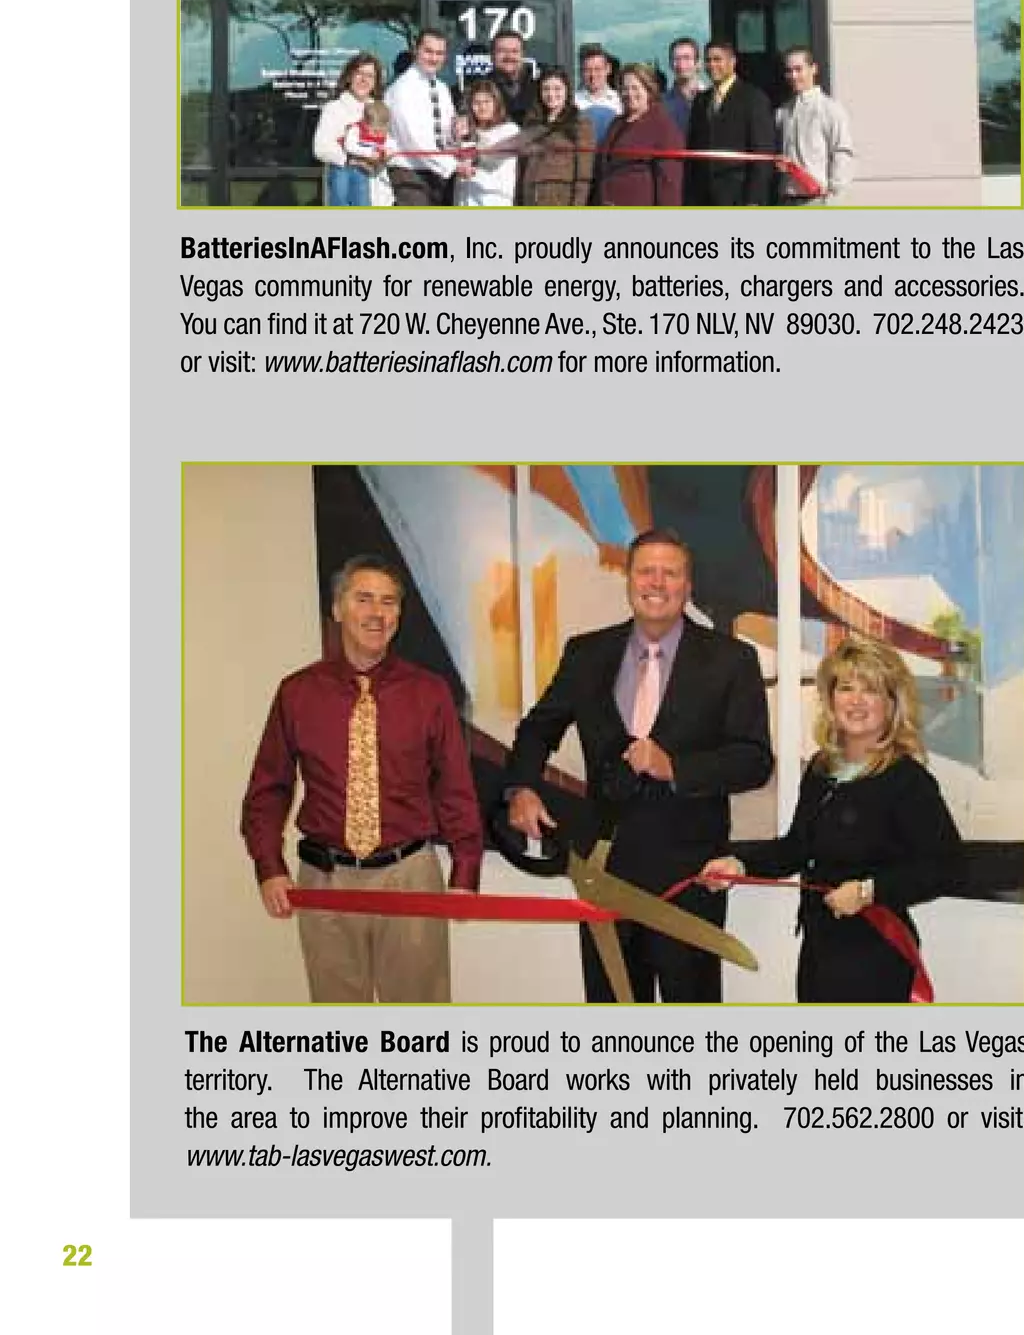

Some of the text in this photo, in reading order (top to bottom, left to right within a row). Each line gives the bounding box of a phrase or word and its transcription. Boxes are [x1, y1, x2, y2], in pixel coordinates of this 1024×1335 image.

[458, 7, 536, 41] 170
[181, 237, 1024, 264] BatteriesInAFlash.com, Inc. proudly announces its commitment to the Las
[181, 350, 780, 373] or visit: www.batteriesinaflash.com for more information.
[185, 1031, 227, 1053] The
[239, 1030, 368, 1053] Alternative
[381, 1031, 449, 1053] Board
[462, 1031, 478, 1053] is
[490, 1031, 549, 1057] proud
[560, 1031, 580, 1053] to
[592, 1035, 694, 1053] announce
[705, 1031, 738, 1053] the
[750, 1031, 832, 1058] opening
[845, 1030, 865, 1053] of
[875, 1031, 908, 1053] the
[920, 1031, 956, 1053] Las
[188, 1144, 491, 1171] www.tab-lasvegaswest.com.
[63, 1244, 92, 1266] 22
